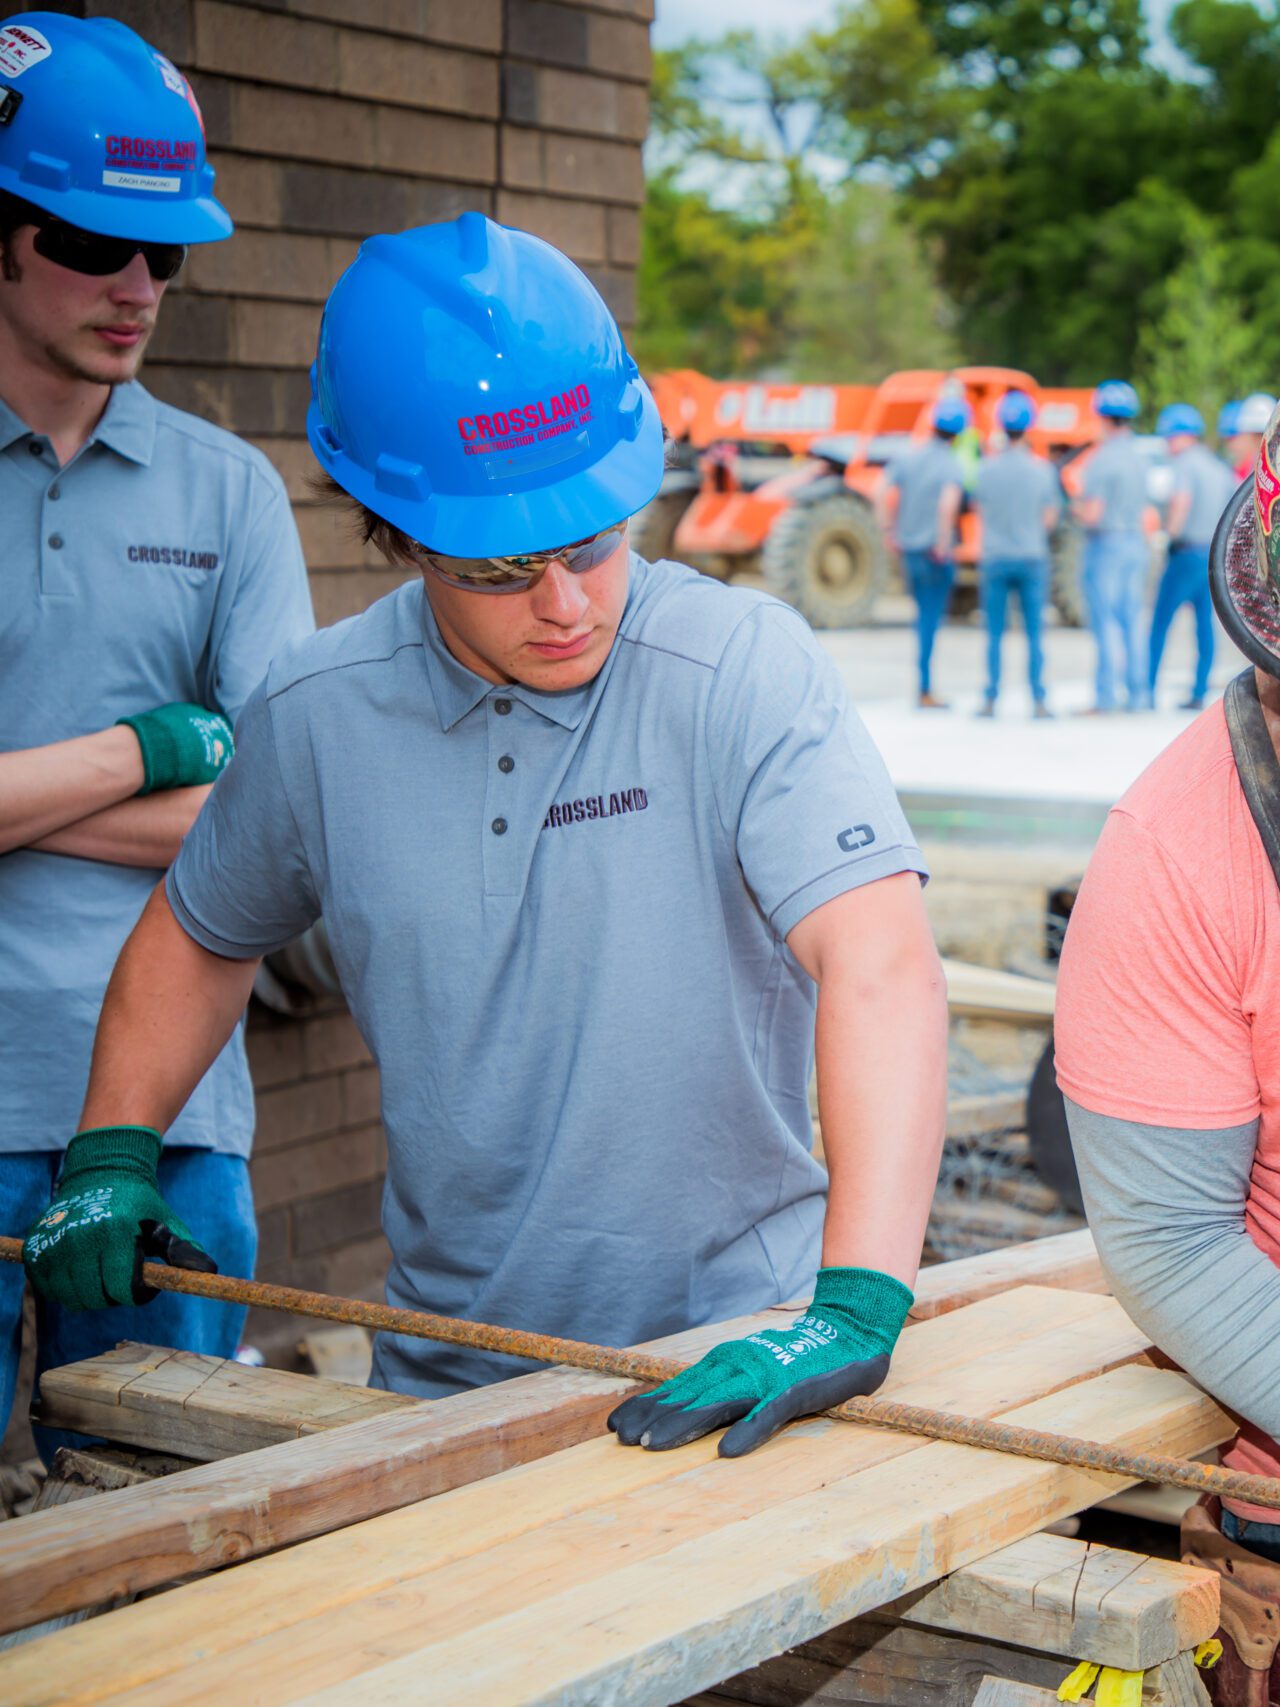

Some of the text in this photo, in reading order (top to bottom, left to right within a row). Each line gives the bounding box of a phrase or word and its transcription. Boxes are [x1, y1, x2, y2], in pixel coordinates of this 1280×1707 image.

[106, 135, 197, 160] CROSSLAND
[456, 383, 592, 442] CROSSLAND
[463, 434, 535, 456] CONSTRUCTION
[127, 545, 218, 570] CROSSLAND
